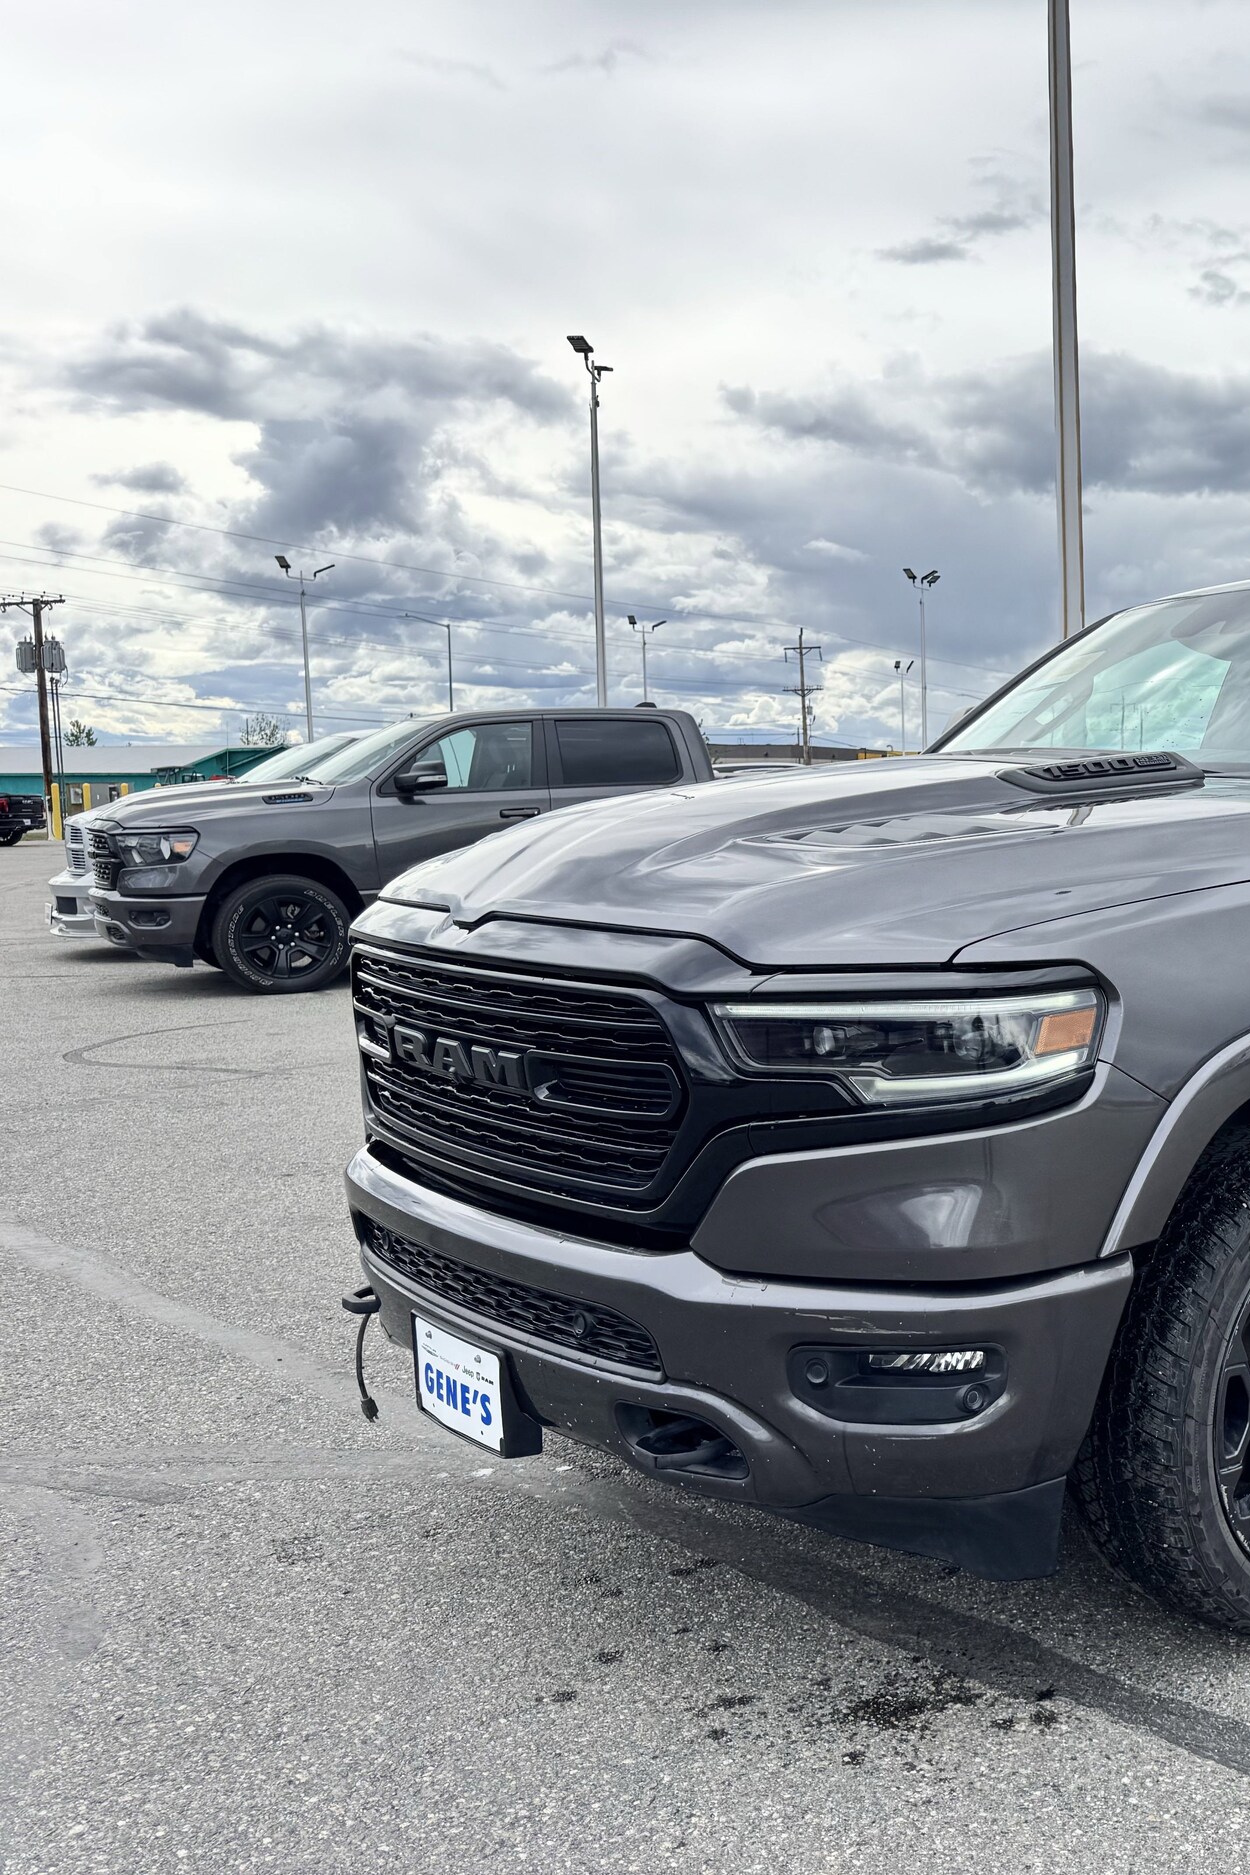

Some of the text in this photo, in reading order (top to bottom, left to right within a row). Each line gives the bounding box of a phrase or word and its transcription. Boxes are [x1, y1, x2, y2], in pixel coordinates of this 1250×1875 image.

[1042, 757, 1136, 779] 1500
[394, 1024, 523, 1089] RAM
[424, 1362, 492, 1426] GENE'S
